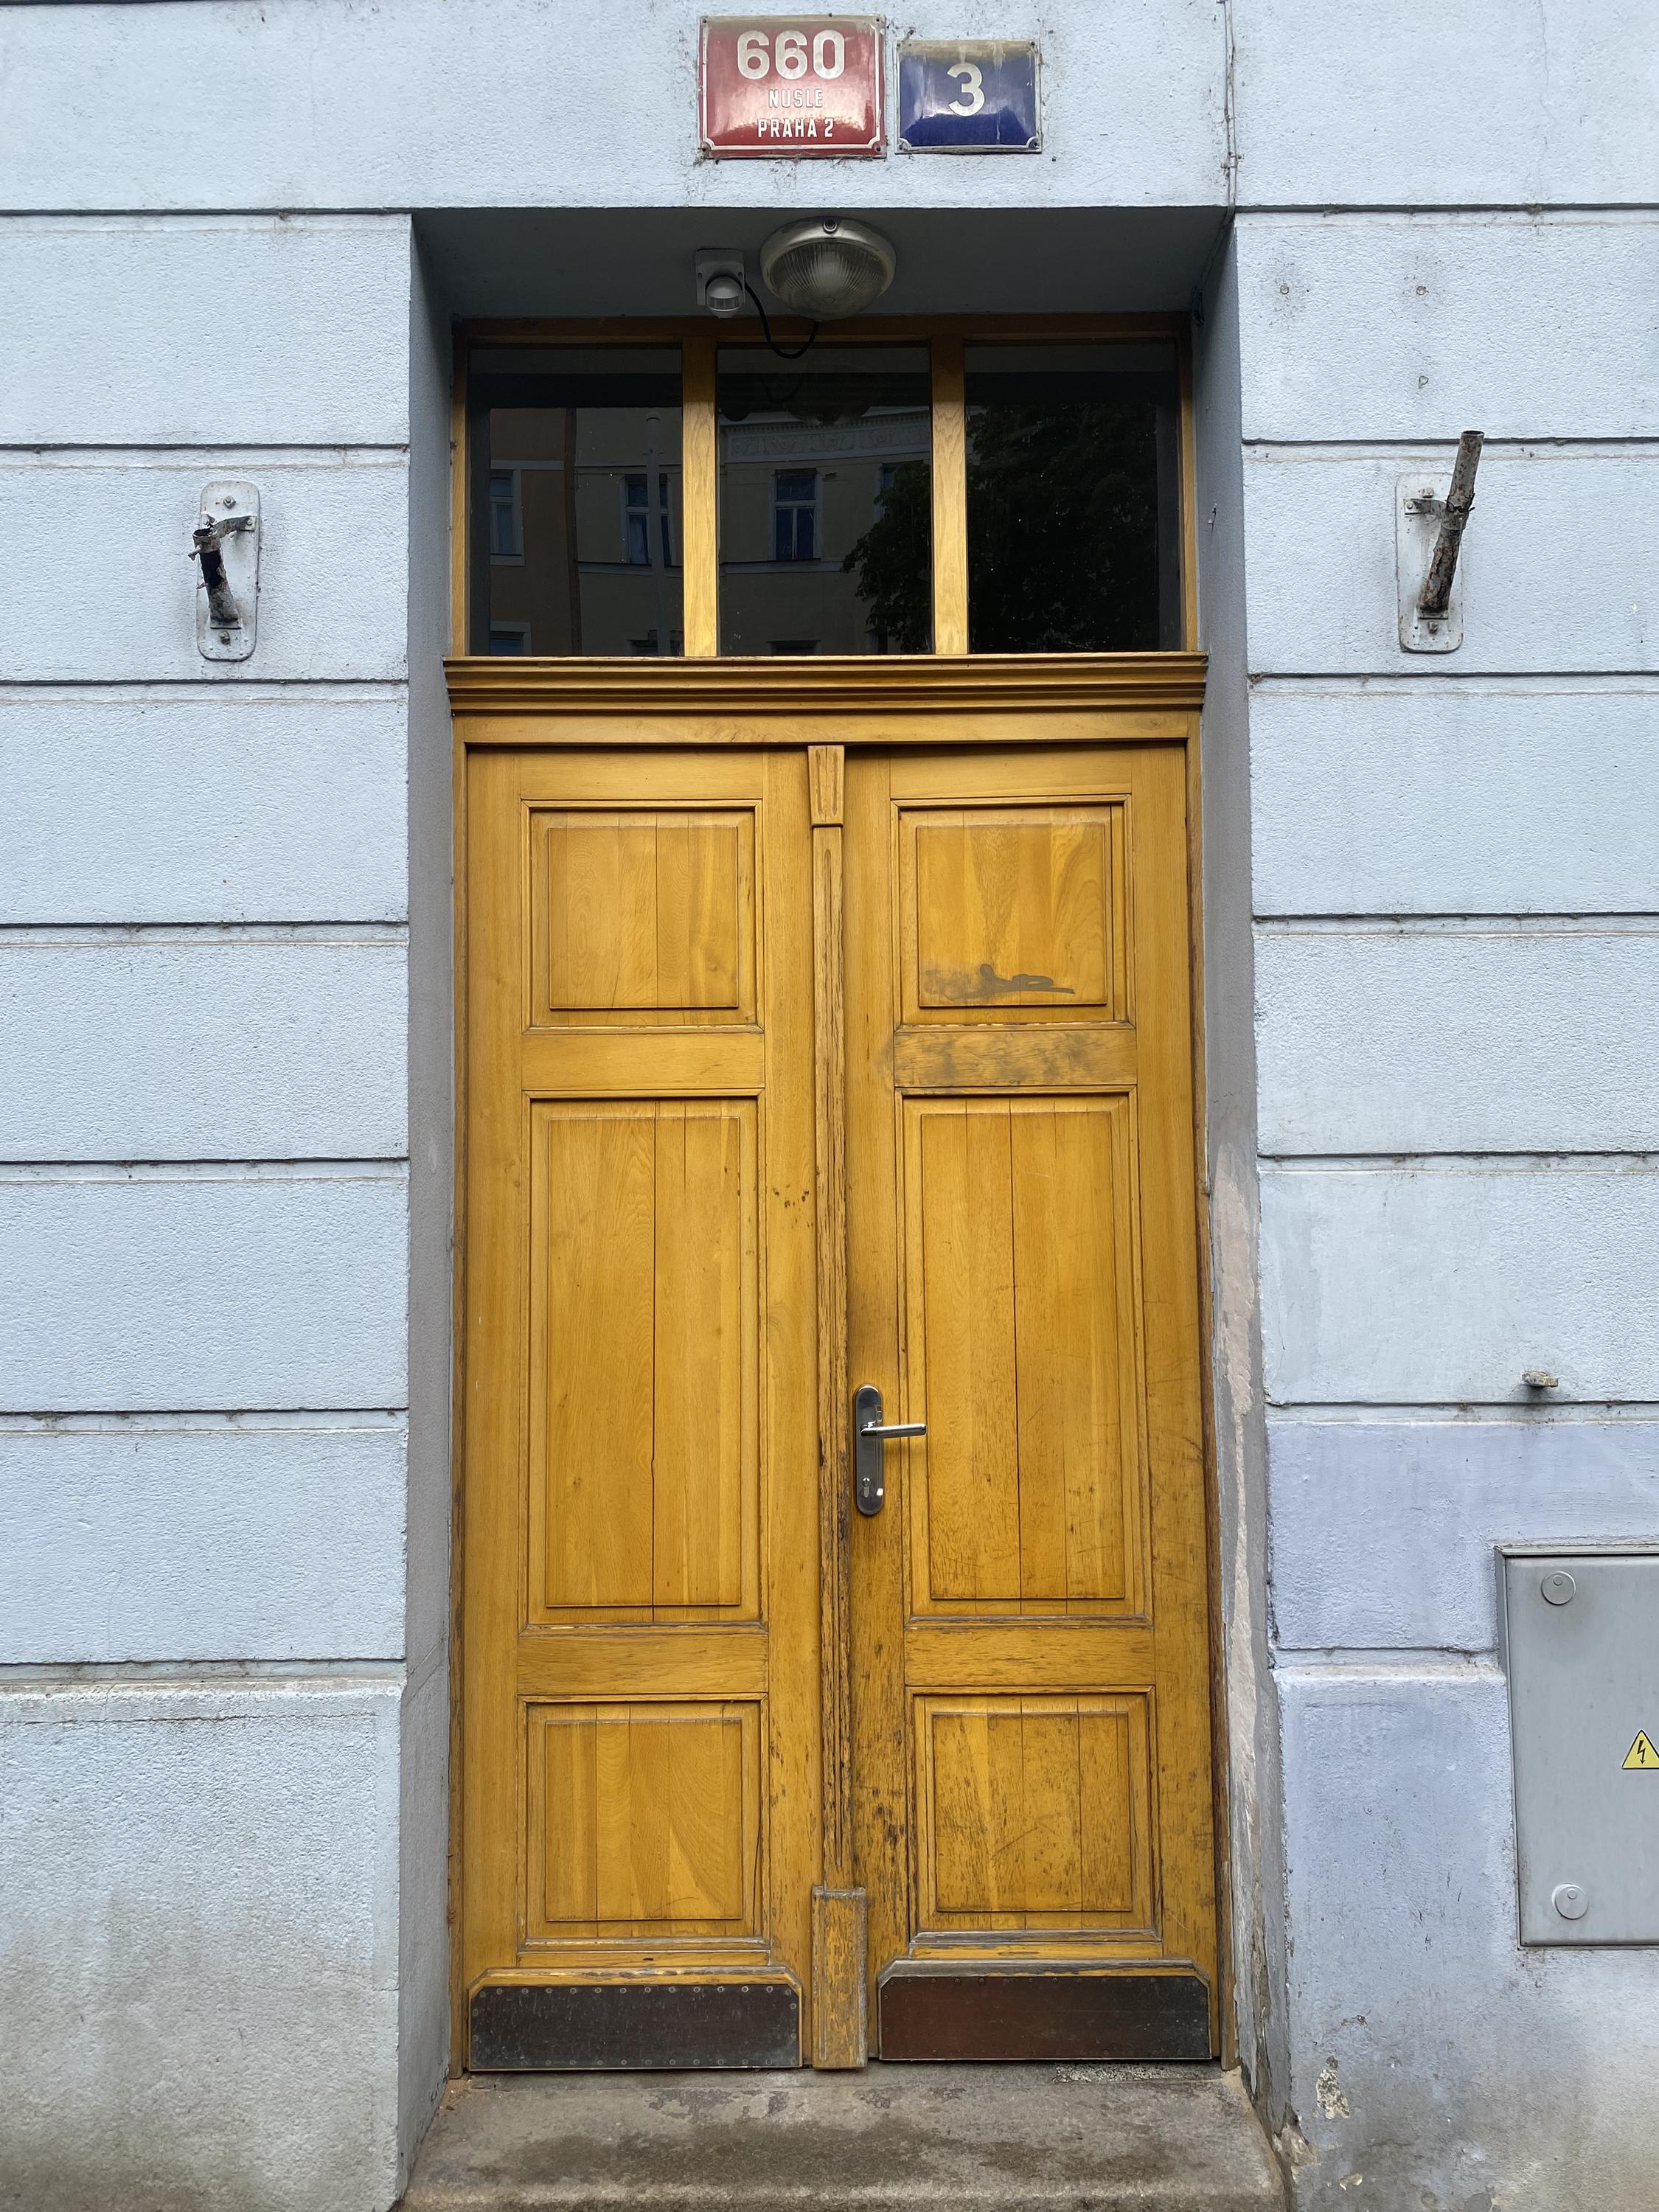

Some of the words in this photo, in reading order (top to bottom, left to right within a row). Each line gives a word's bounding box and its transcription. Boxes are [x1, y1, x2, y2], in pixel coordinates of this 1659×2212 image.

[737, 29, 845, 80] 660
[768, 88, 823, 108] NUSLE
[947, 62, 985, 116] 3
[757, 118, 817, 138] PRAHA
[824, 118, 834, 138] 2
